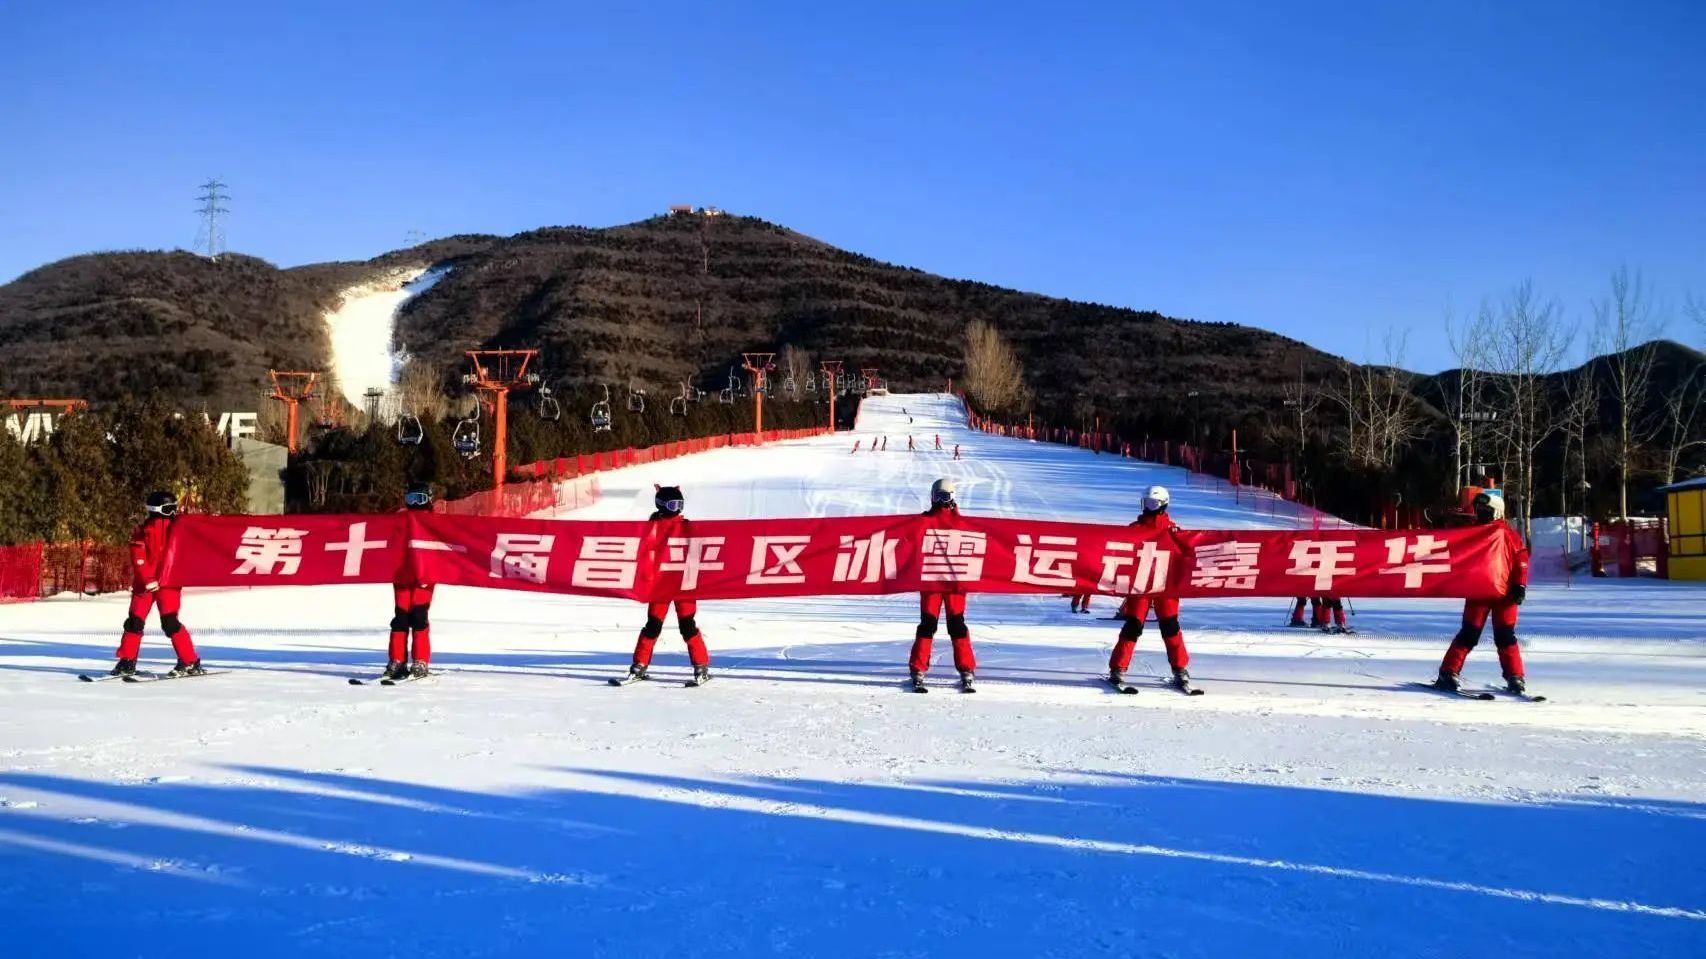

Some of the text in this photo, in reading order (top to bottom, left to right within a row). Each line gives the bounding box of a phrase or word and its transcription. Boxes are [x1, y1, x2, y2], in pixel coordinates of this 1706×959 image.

[231, 521, 1452, 595] 第十一届昌平区冰雪运动嘉年华
